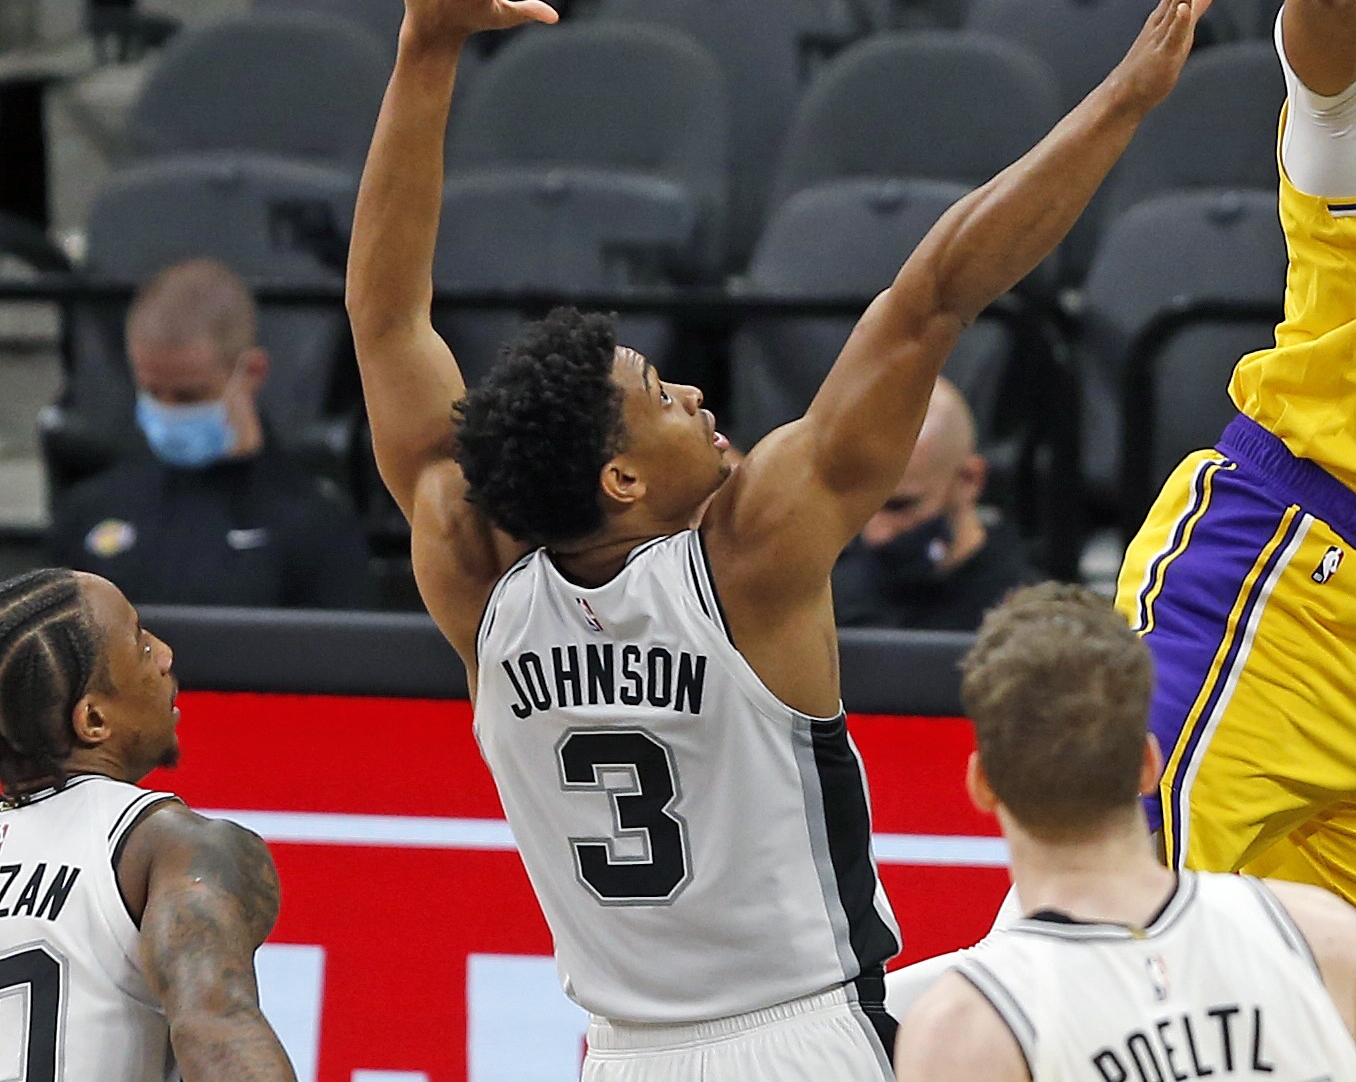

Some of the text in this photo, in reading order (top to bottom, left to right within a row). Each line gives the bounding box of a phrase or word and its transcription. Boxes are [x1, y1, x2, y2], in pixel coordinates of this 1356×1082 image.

[501, 643, 708, 719] JOHNSON
[555, 724, 694, 906] 3
[1093, 1008, 1274, 1082] POELTL
